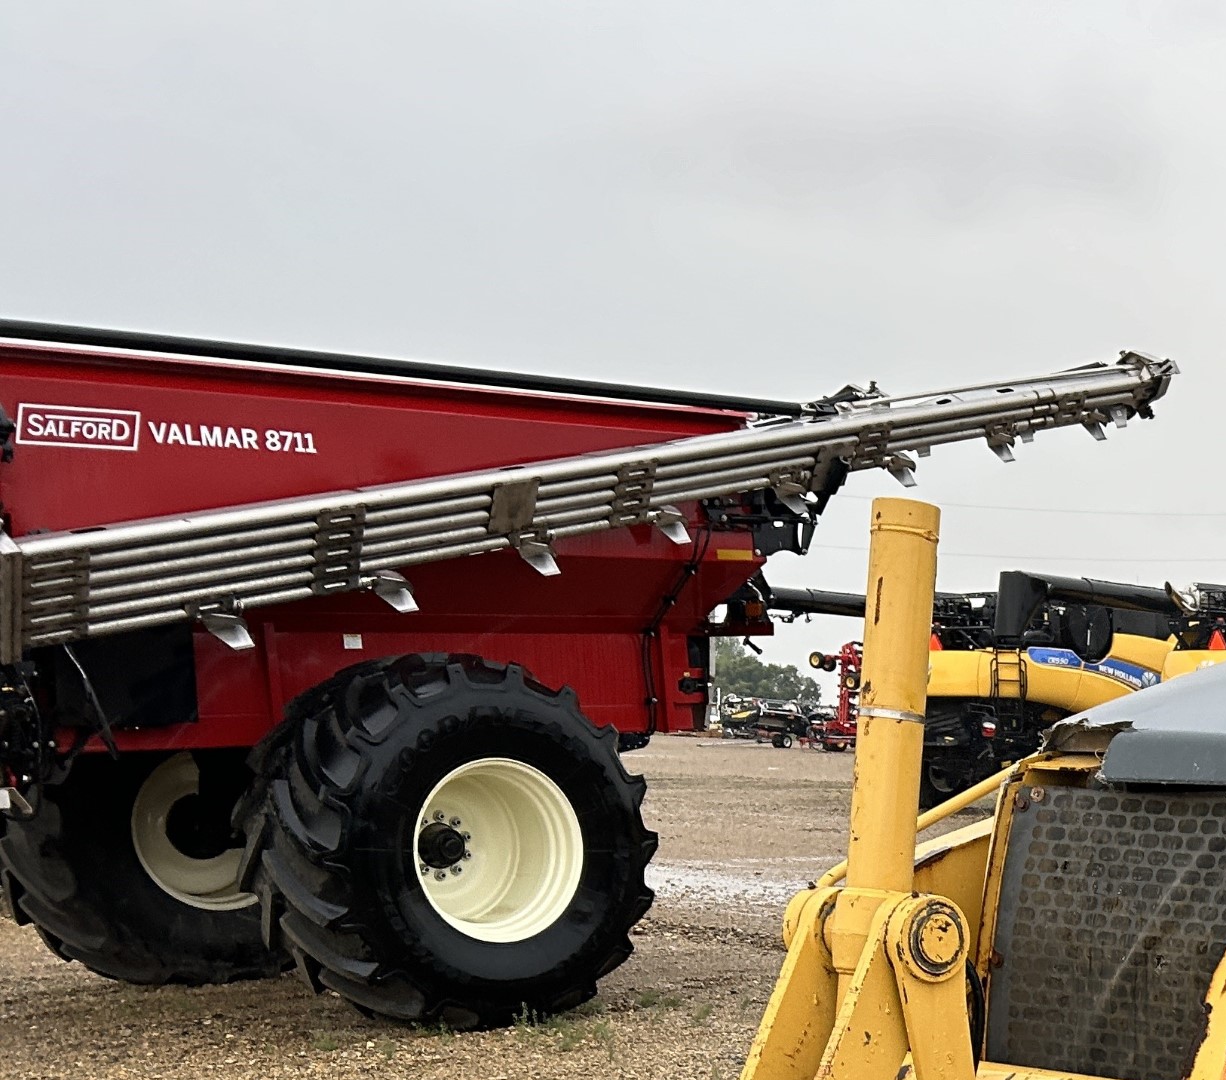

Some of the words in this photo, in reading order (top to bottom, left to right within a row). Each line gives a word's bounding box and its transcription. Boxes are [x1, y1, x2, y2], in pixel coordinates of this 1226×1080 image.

[27, 412, 131, 442] SALFORD
[147, 420, 260, 450] VALMAR
[264, 429, 318, 454] 8711
[1098, 664, 1114, 675] NEW
[1114, 668, 1142, 688] HOLLAND
